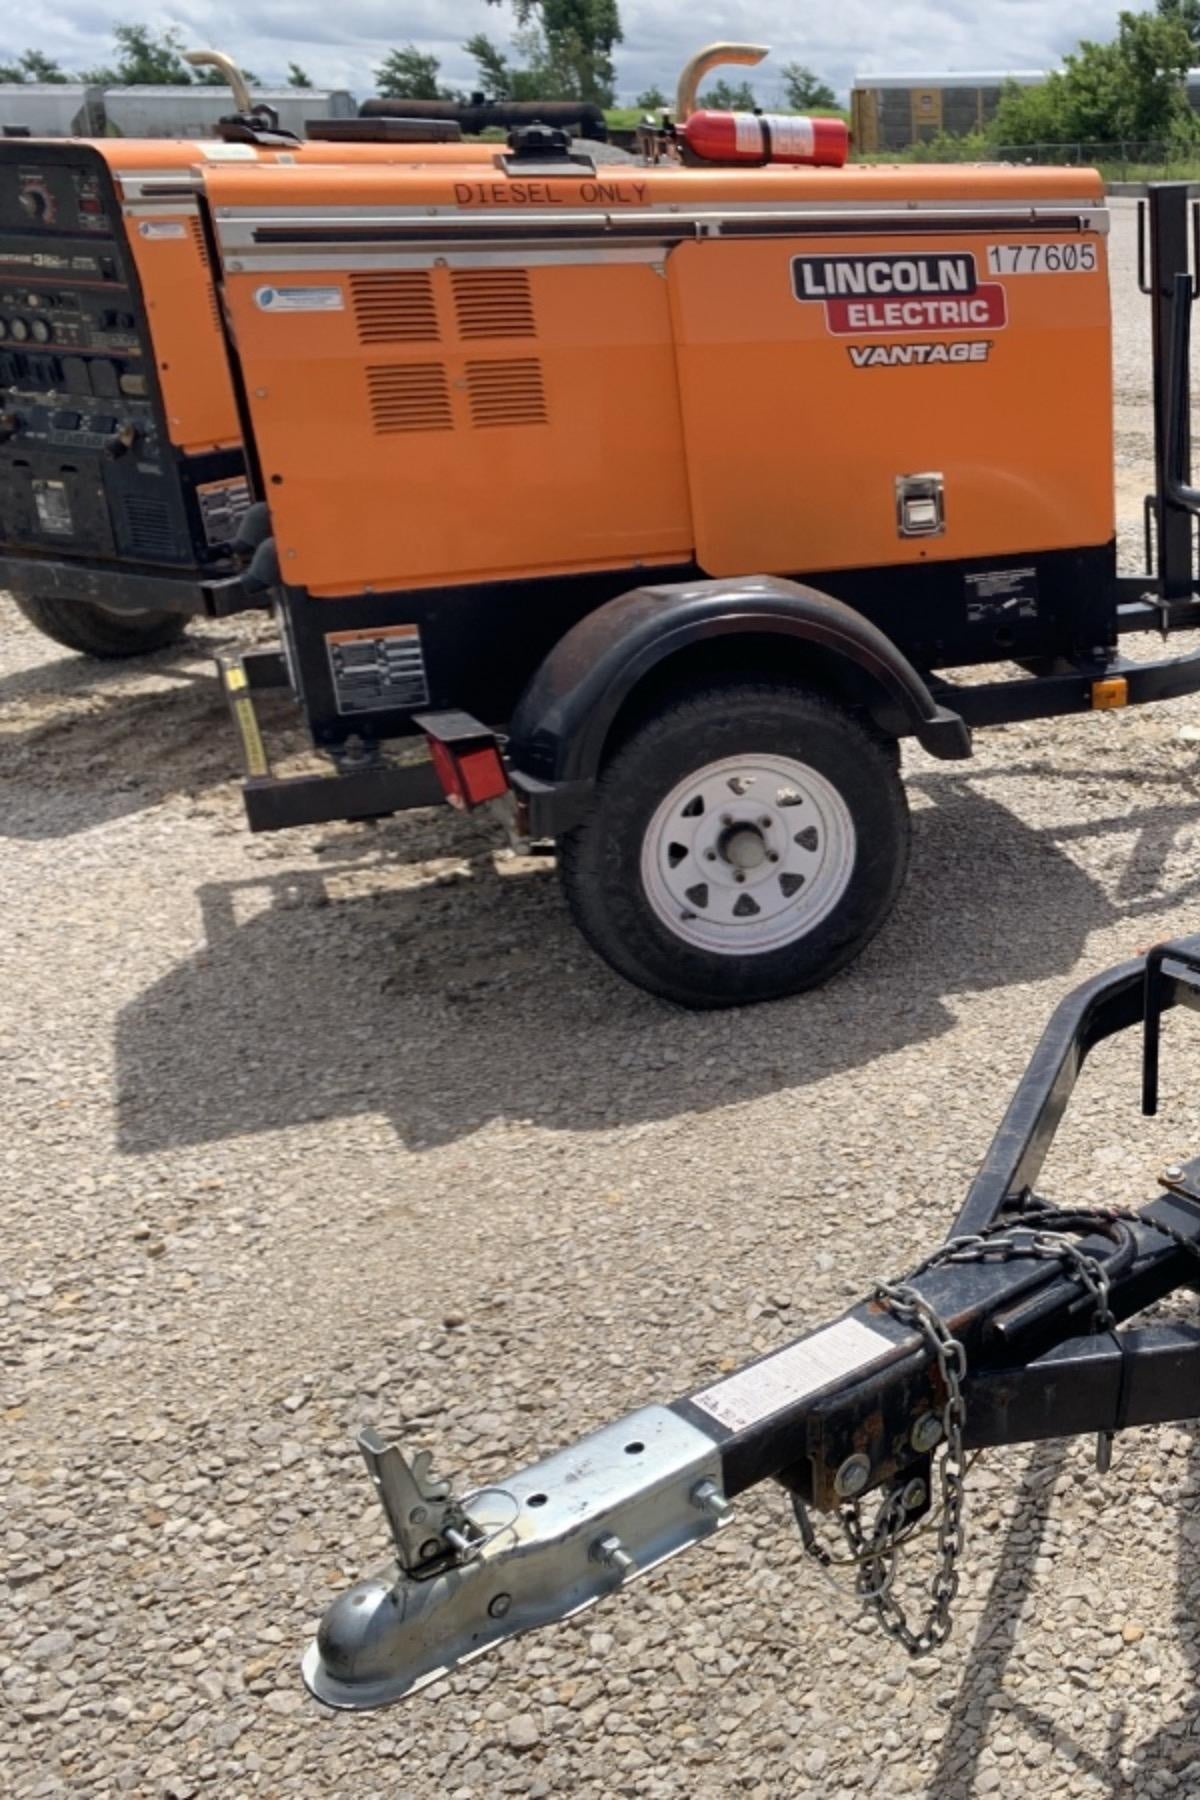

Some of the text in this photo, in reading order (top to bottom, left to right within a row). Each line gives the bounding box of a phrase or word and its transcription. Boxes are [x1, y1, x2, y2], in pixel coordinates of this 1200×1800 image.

[454, 183, 648, 204] DIESEL ONLY
[989, 244, 1096, 272] 177605
[801, 259, 969, 295] LINCOLN
[847, 300, 990, 327] ELECTRIC
[848, 343, 990, 366] VANTAGE
